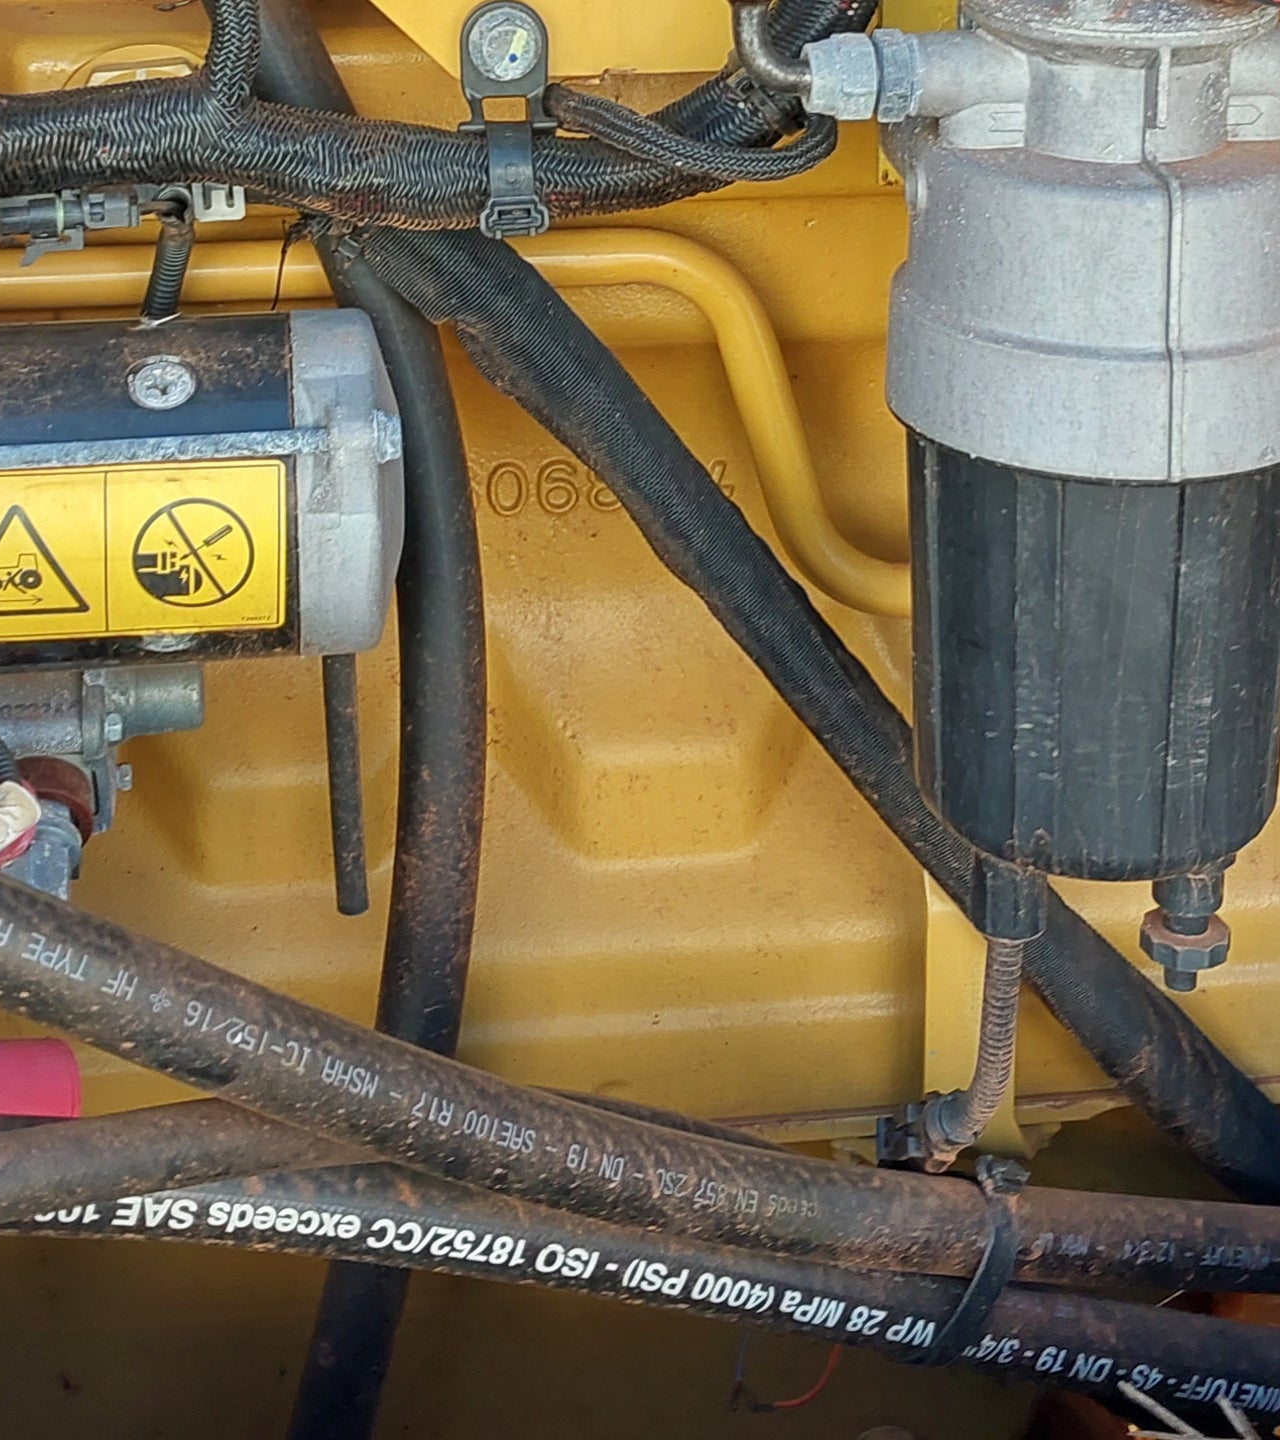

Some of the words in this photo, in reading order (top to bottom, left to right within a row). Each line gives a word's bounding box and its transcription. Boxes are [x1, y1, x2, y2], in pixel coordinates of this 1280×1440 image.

[23, 932, 92, 983] TYPE
[100, 969, 140, 1002] HF
[320, 1055, 381, 1101] MSHA
[566, 1143, 593, 1173] 19
[111, 1195, 198, 1230] SAE
[206, 1200, 362, 1239] exceeds
[367, 1219, 528, 1266] 18752/CC
[534, 1243, 600, 1279] ISO
[621, 1257, 690, 1296] PSI)
[690, 1271, 776, 1313] (4000
[778, 1288, 848, 1329] MPa
[845, 1304, 889, 1336] 28
[884, 1315, 938, 1348] WP
[1034, 1345, 1069, 1373] 19
[1068, 1352, 1114, 1383] DN
